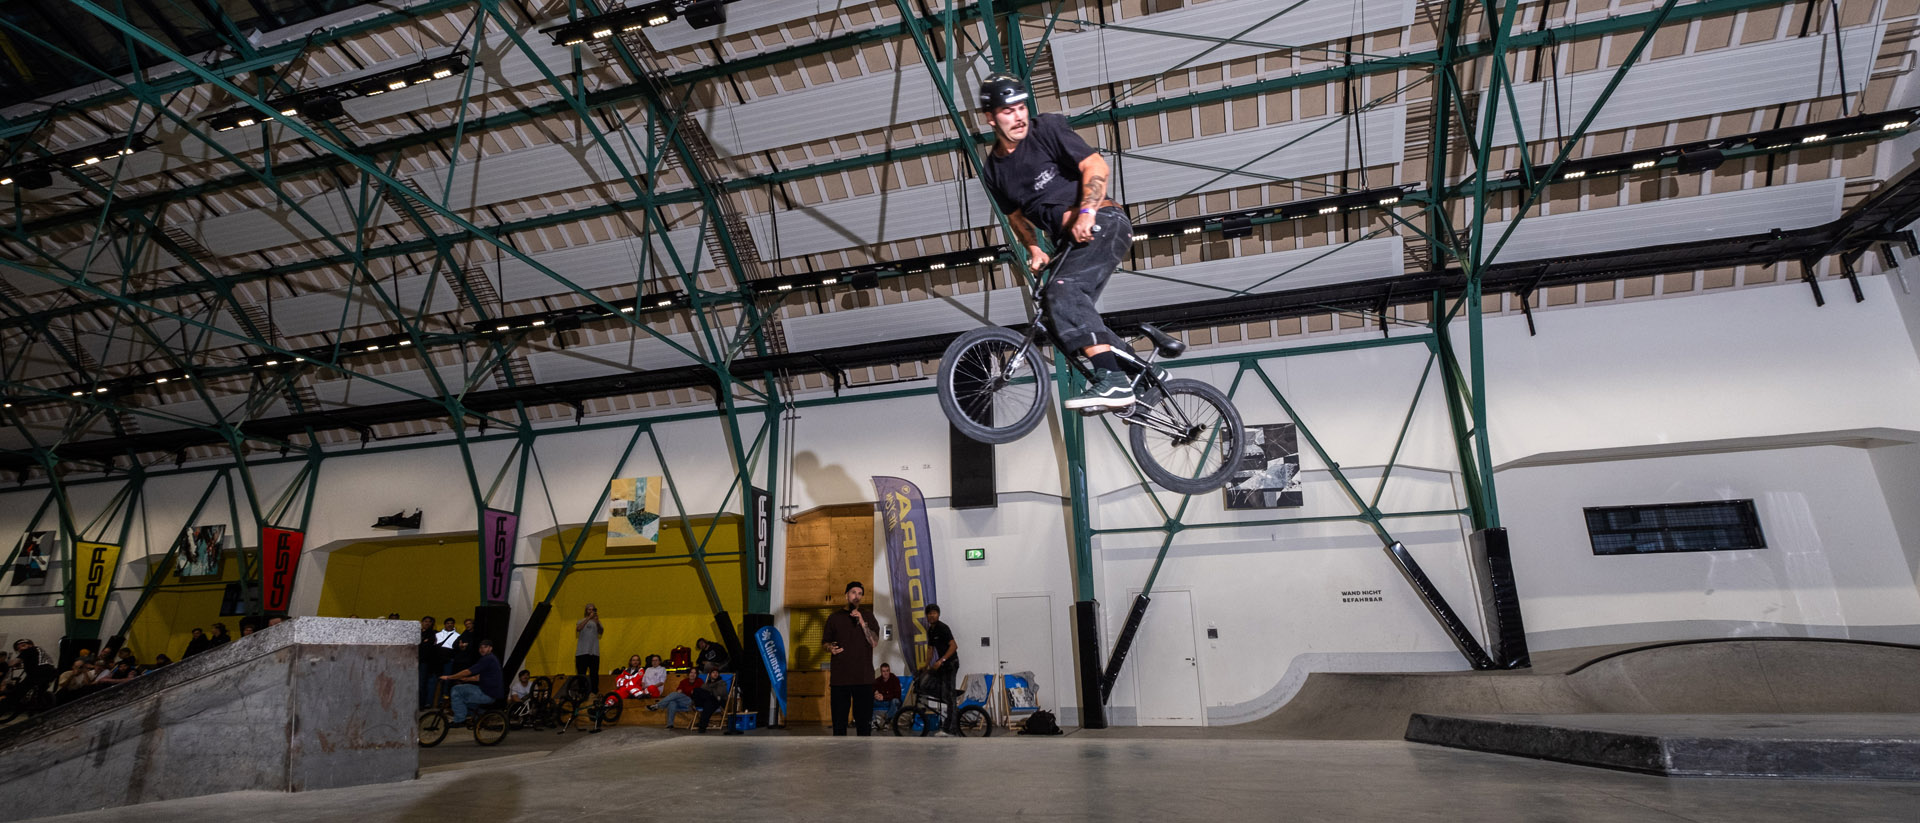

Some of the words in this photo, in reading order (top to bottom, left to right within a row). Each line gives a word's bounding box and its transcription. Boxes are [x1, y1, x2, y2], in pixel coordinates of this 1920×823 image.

[270, 533, 291, 608] CASA
[491, 516, 507, 598] CASA
[758, 495, 767, 586] CASA
[82, 547, 107, 617] CASA
[764, 640, 784, 682] Chiemseer
